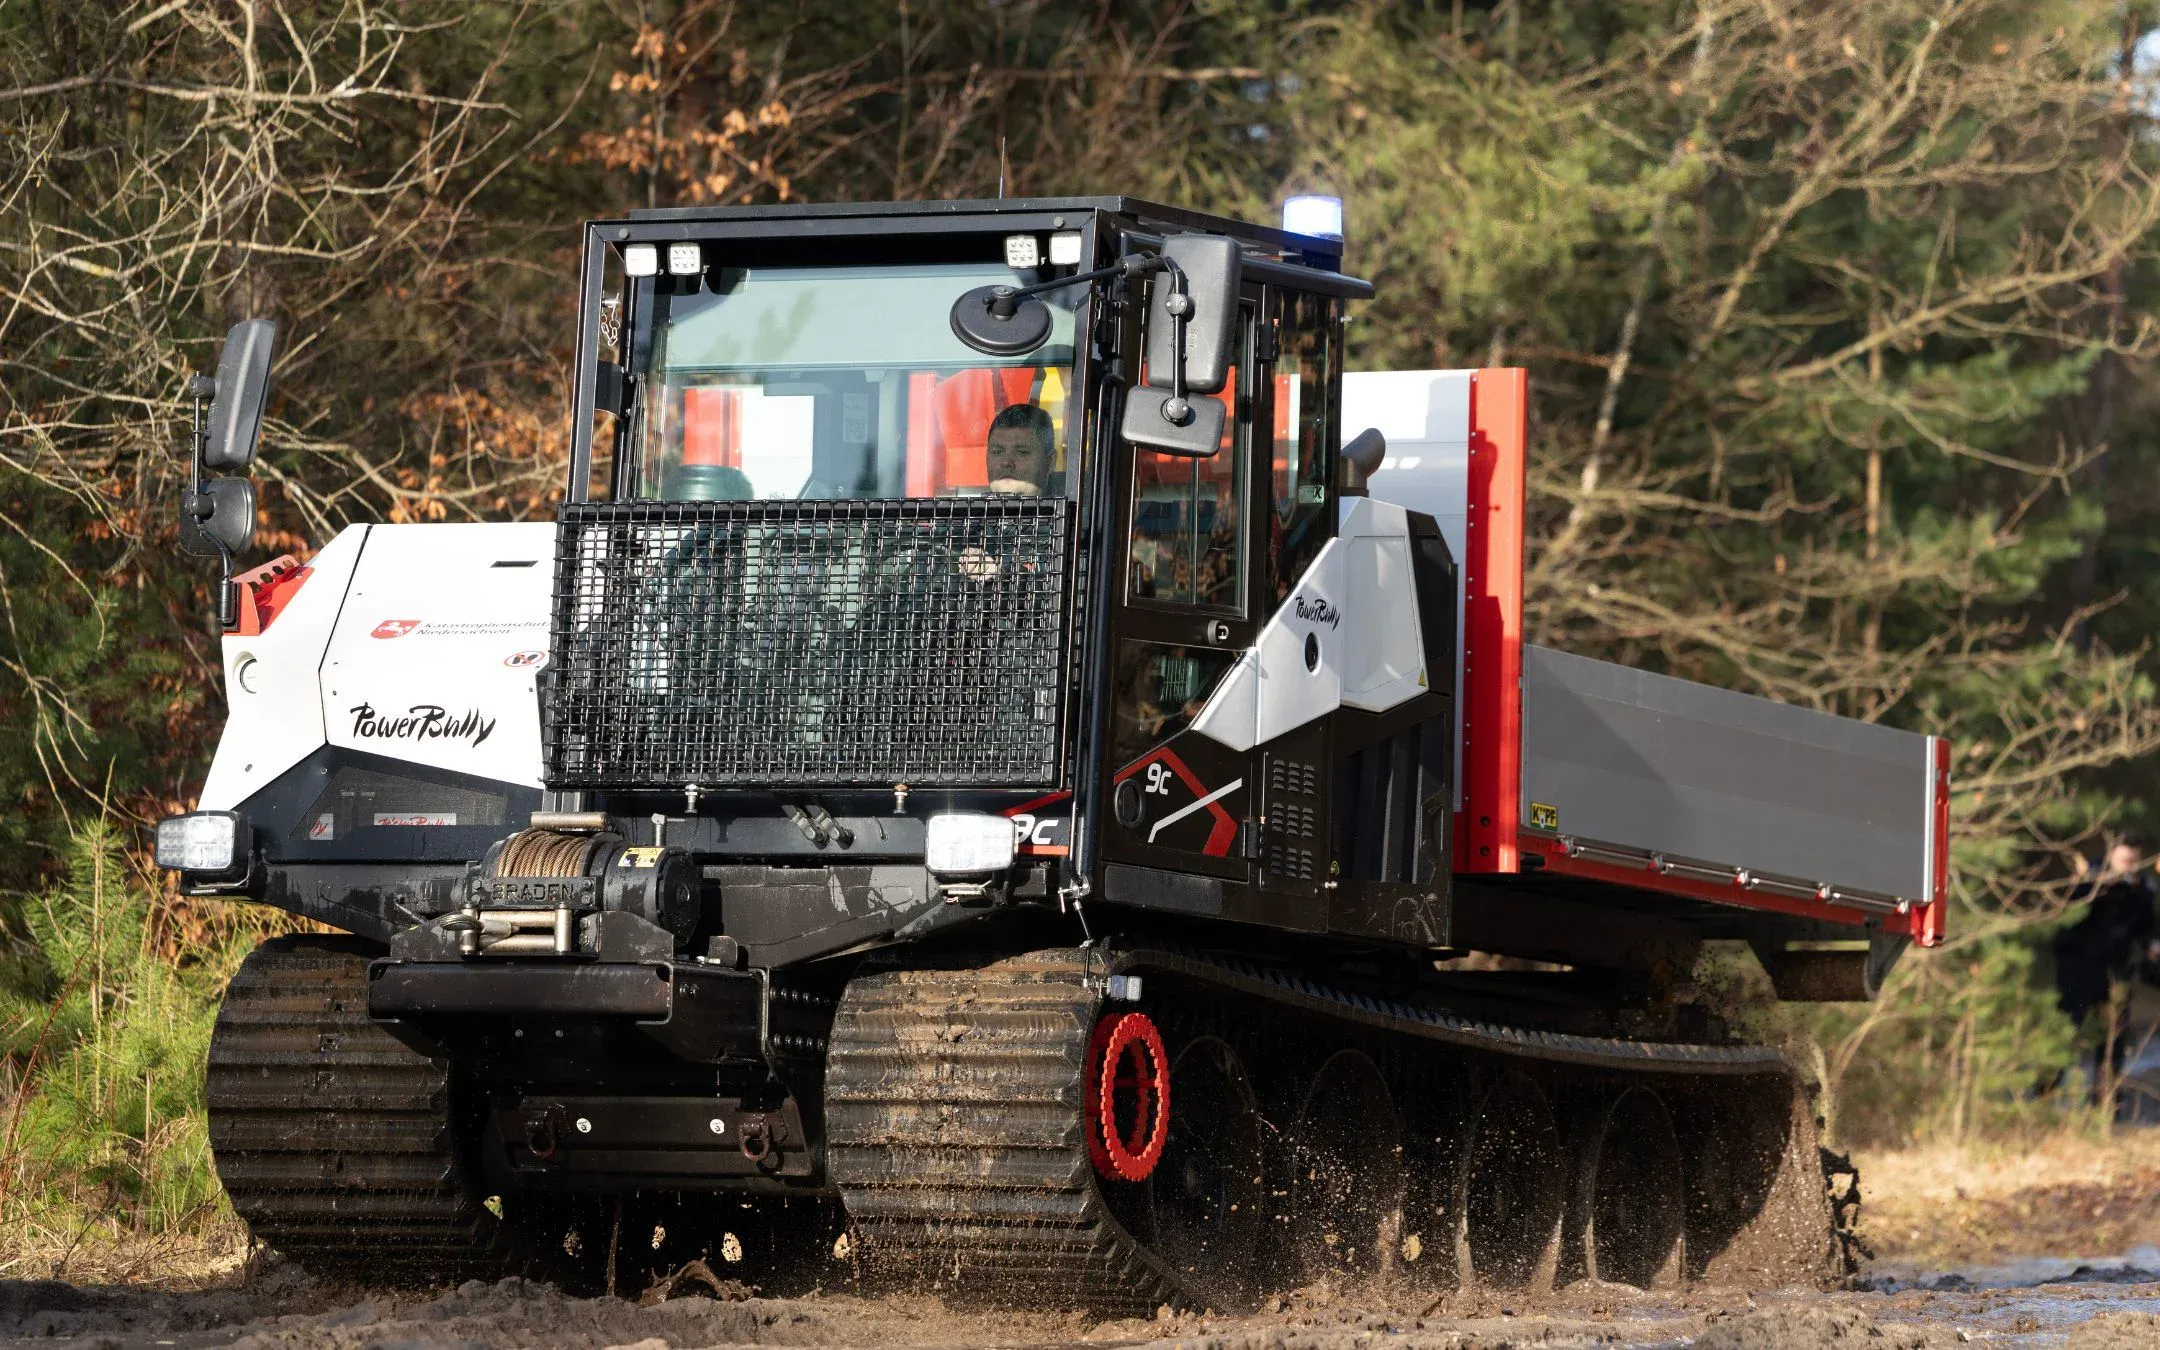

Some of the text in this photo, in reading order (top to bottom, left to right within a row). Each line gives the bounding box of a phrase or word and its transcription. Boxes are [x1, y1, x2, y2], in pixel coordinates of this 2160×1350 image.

[1295, 594, 1341, 632] PowerBully
[350, 702, 497, 748] PowerBully
[493, 883, 574, 901] BRADEN
